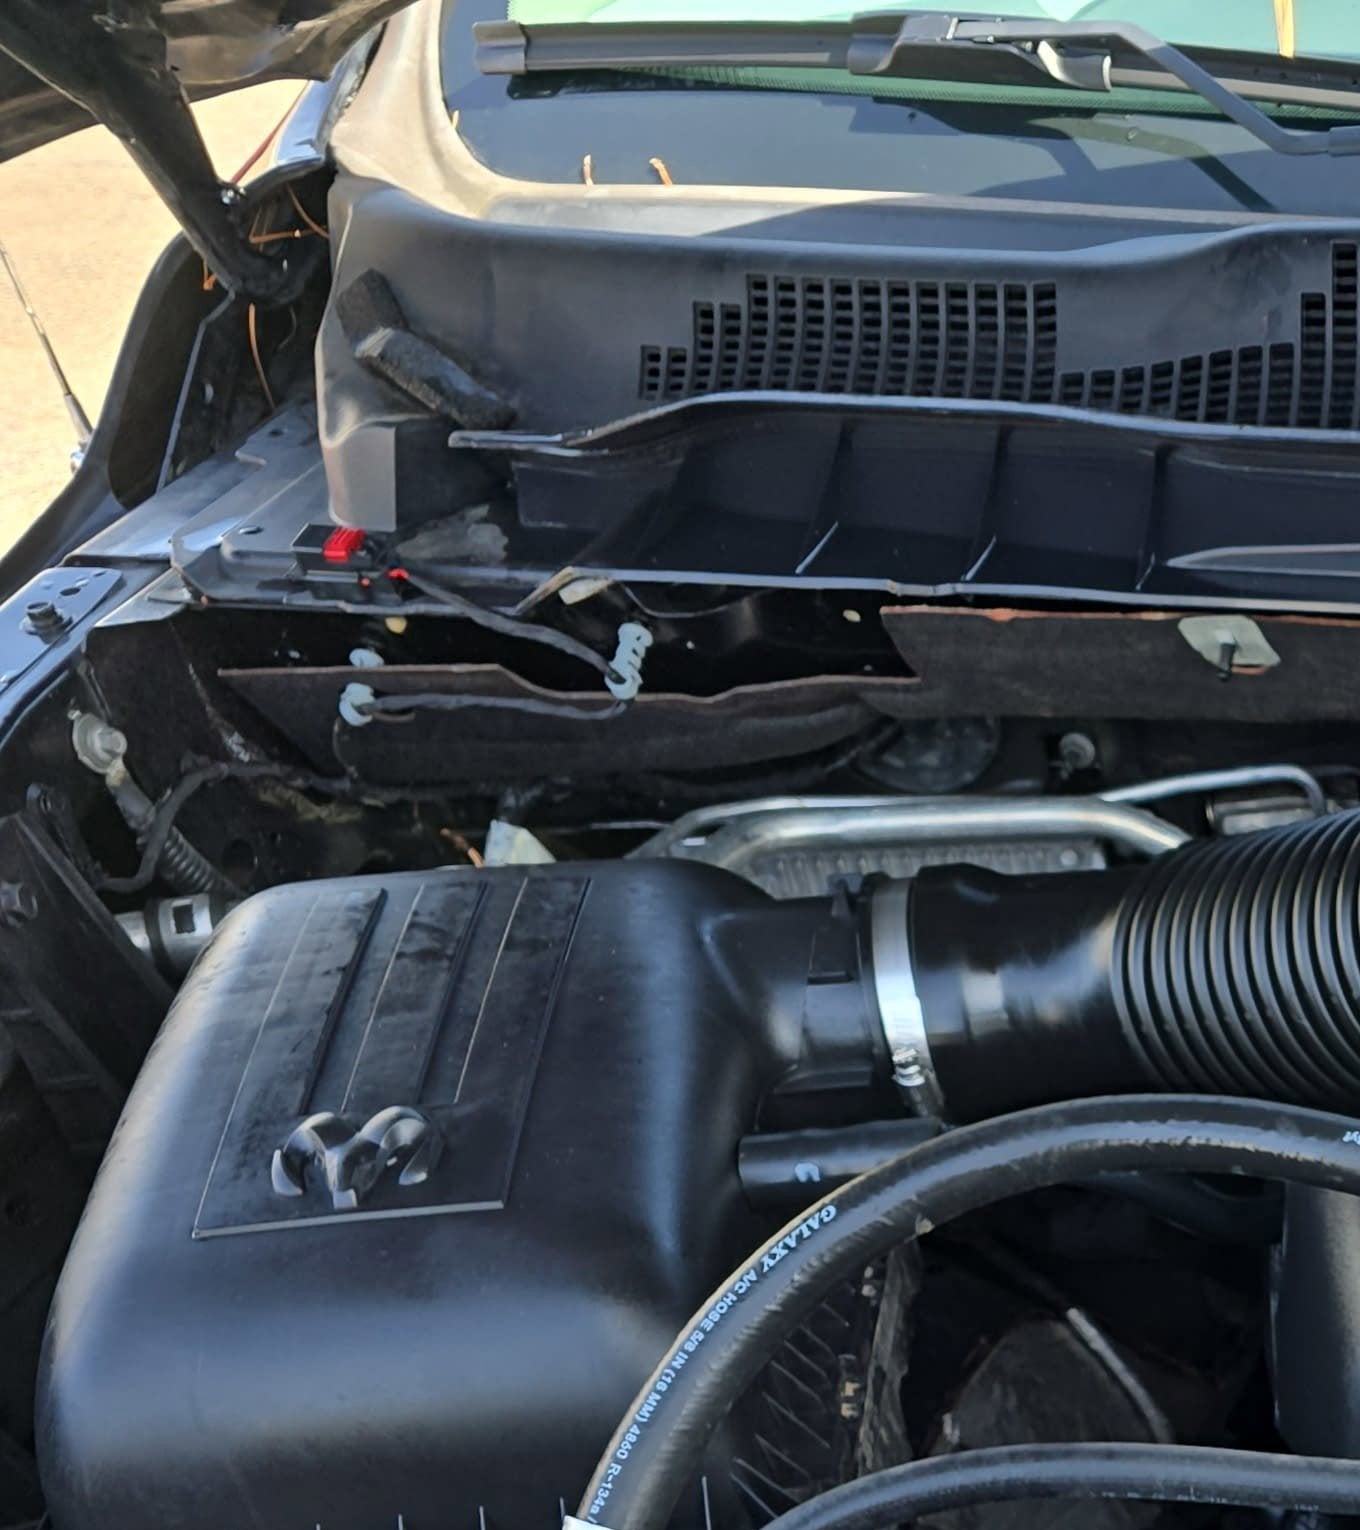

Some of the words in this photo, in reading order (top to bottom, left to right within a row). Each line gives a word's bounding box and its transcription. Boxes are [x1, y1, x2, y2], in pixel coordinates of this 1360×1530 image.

[760, 1204, 837, 1273] GALAXY
[733, 1268, 758, 1294] A/C
[700, 1291, 738, 1332] HOSE
[684, 1329, 705, 1353] 5/8
[671, 1350, 689, 1369] IN
[655, 1367, 677, 1393] (16
[634, 1391, 662, 1422] MM)
[616, 1424, 641, 1460] 4860
[590, 1462, 622, 1514] R-134a
